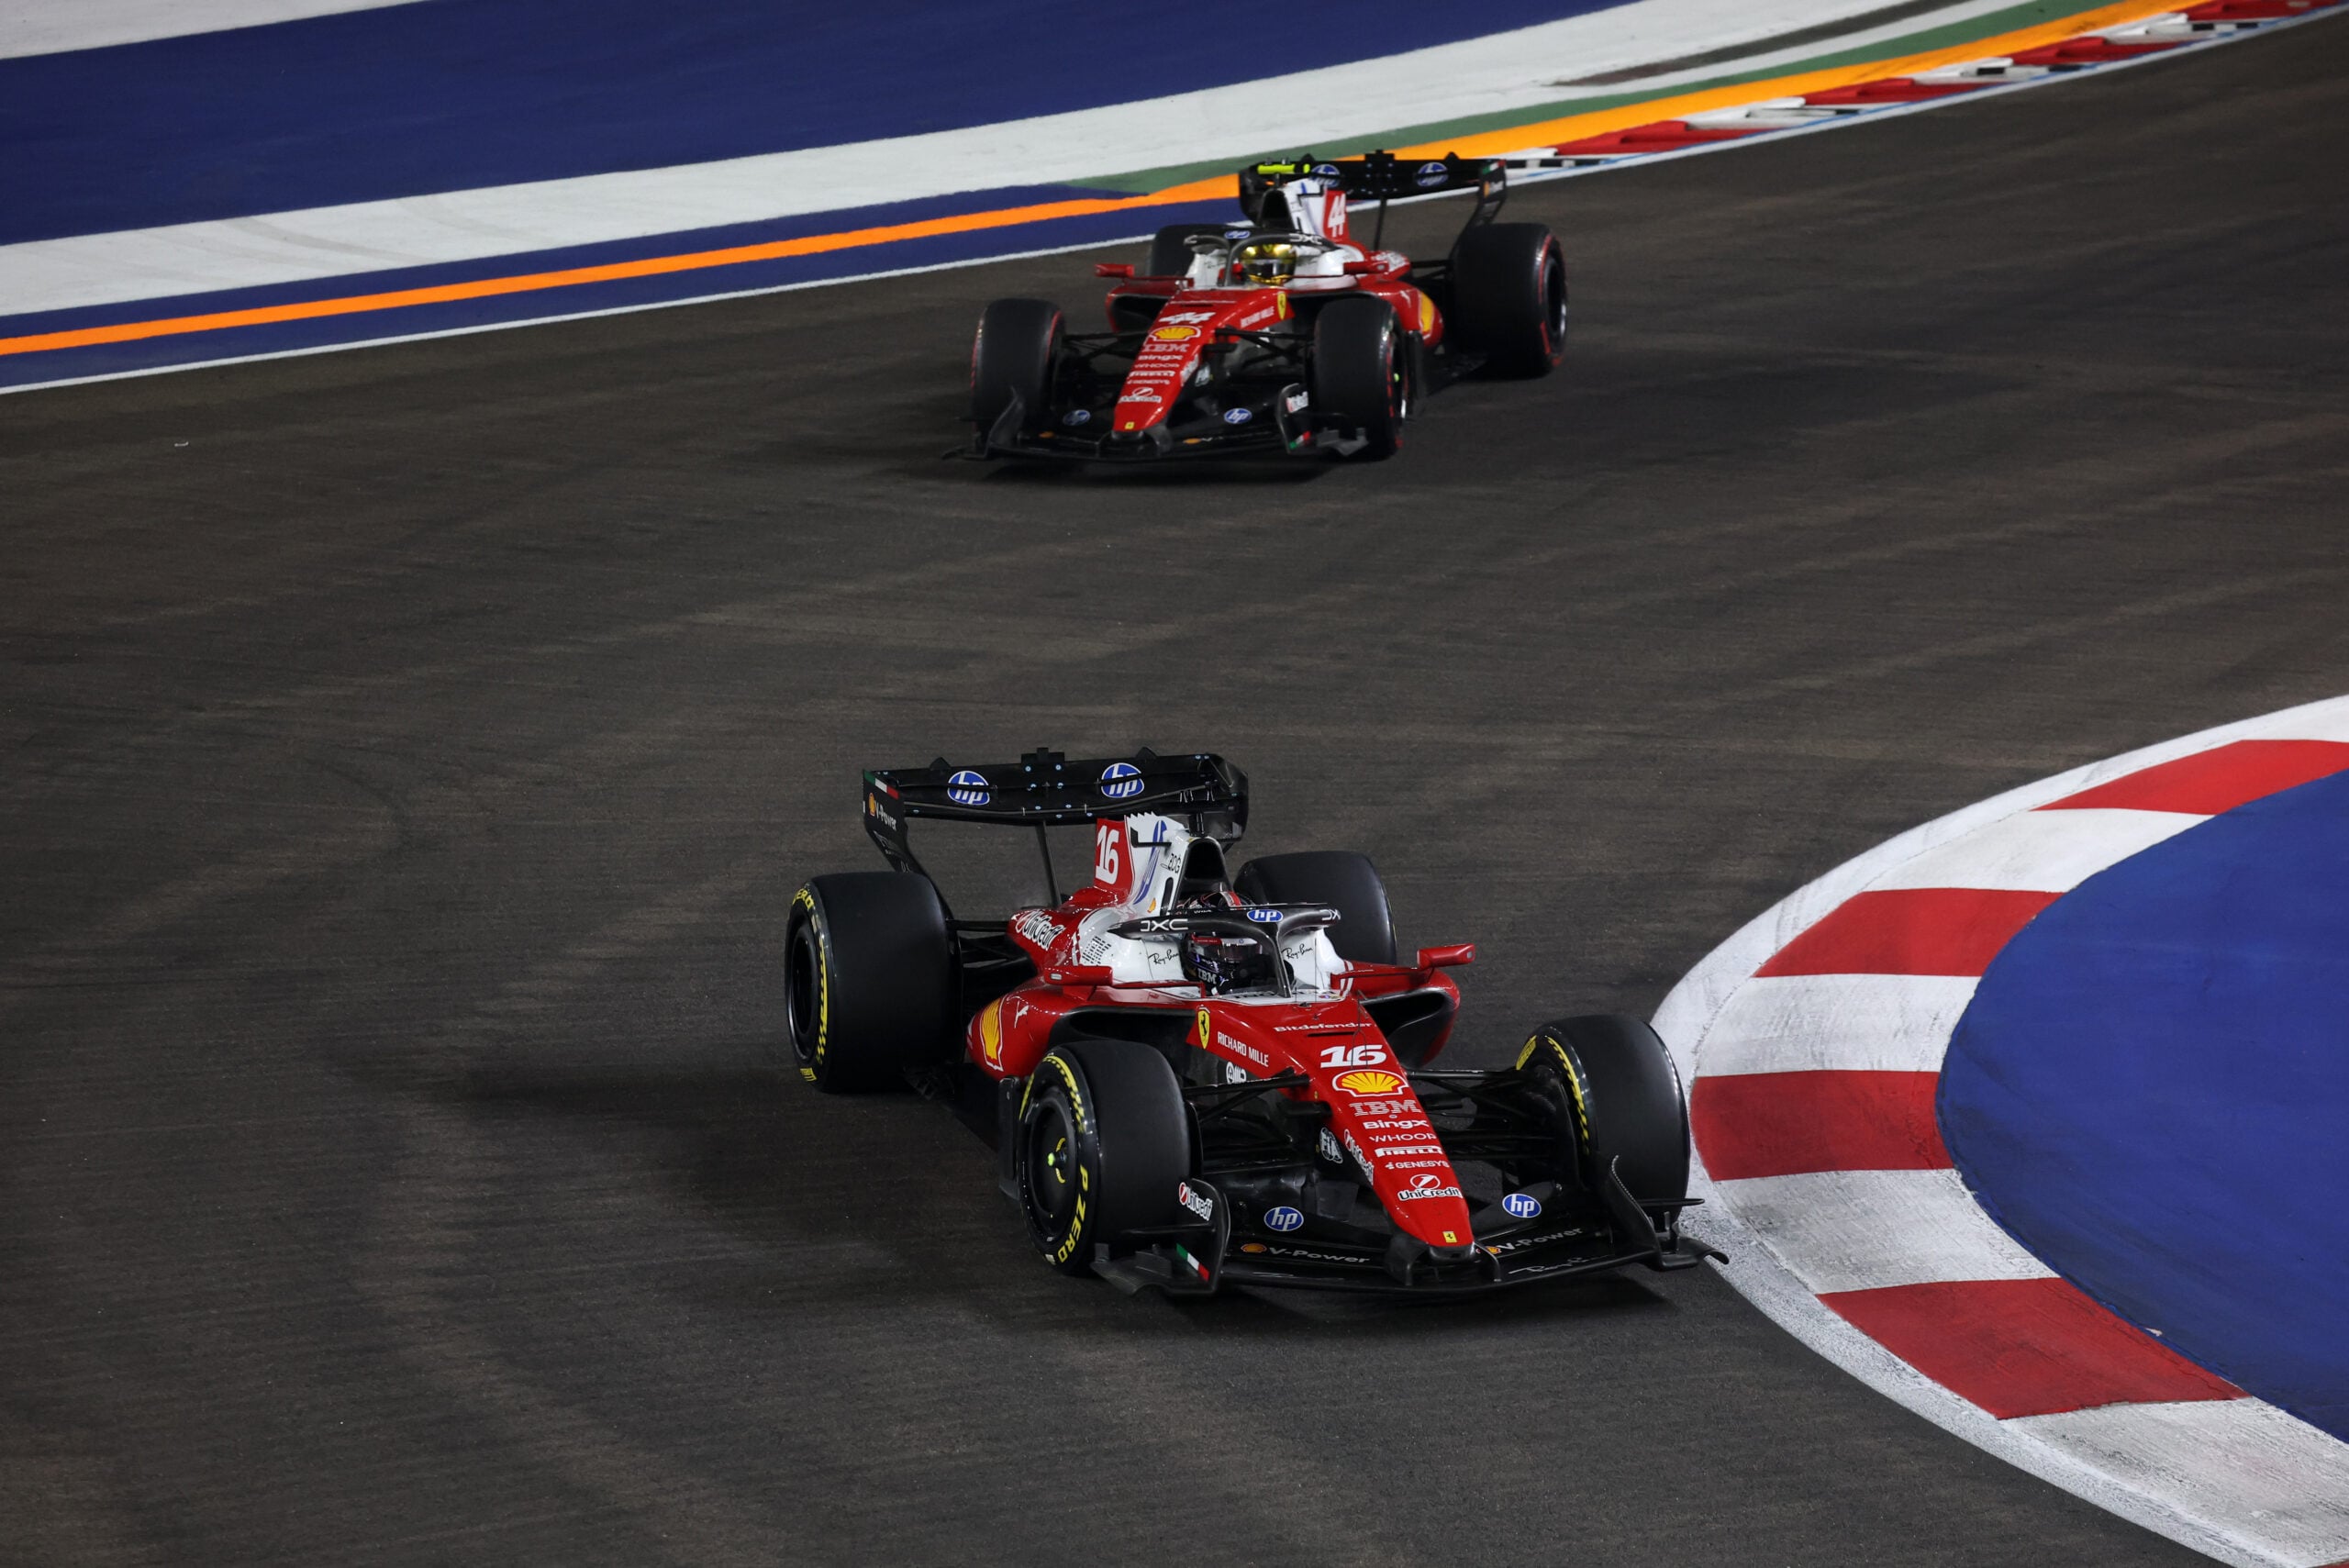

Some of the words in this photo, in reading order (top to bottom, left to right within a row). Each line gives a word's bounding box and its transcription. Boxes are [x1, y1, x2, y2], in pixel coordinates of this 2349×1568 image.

[1328, 193, 1346, 238] 44
[1159, 312, 1216, 325] 44
[1141, 344, 1190, 352] IBM
[953, 771, 986, 805] hp
[1108, 762, 1139, 798] hp
[1096, 825, 1119, 885] 16
[1253, 909, 1278, 923] hp
[1281, 943, 1313, 960] Ray-Ban
[1197, 969, 1218, 985] IBM
[1274, 1022, 1372, 1032] Bitdefender
[1218, 1030, 1247, 1057] RICHARD
[1248, 1046, 1269, 1068] MILLE
[1320, 1044, 1387, 1069] 16
[1349, 1099, 1421, 1117] IBM
[1375, 1145, 1444, 1158] PIRELLI
[1079, 1163, 1089, 1193] P
[1397, 1186, 1464, 1202] UniCredit
[1508, 1194, 1535, 1218] hp
[1057, 1194, 1086, 1263] ZERO
[1270, 1207, 1299, 1231] hp
[1498, 1228, 1584, 1251] V-Power
[1269, 1248, 1373, 1264] V-Power
